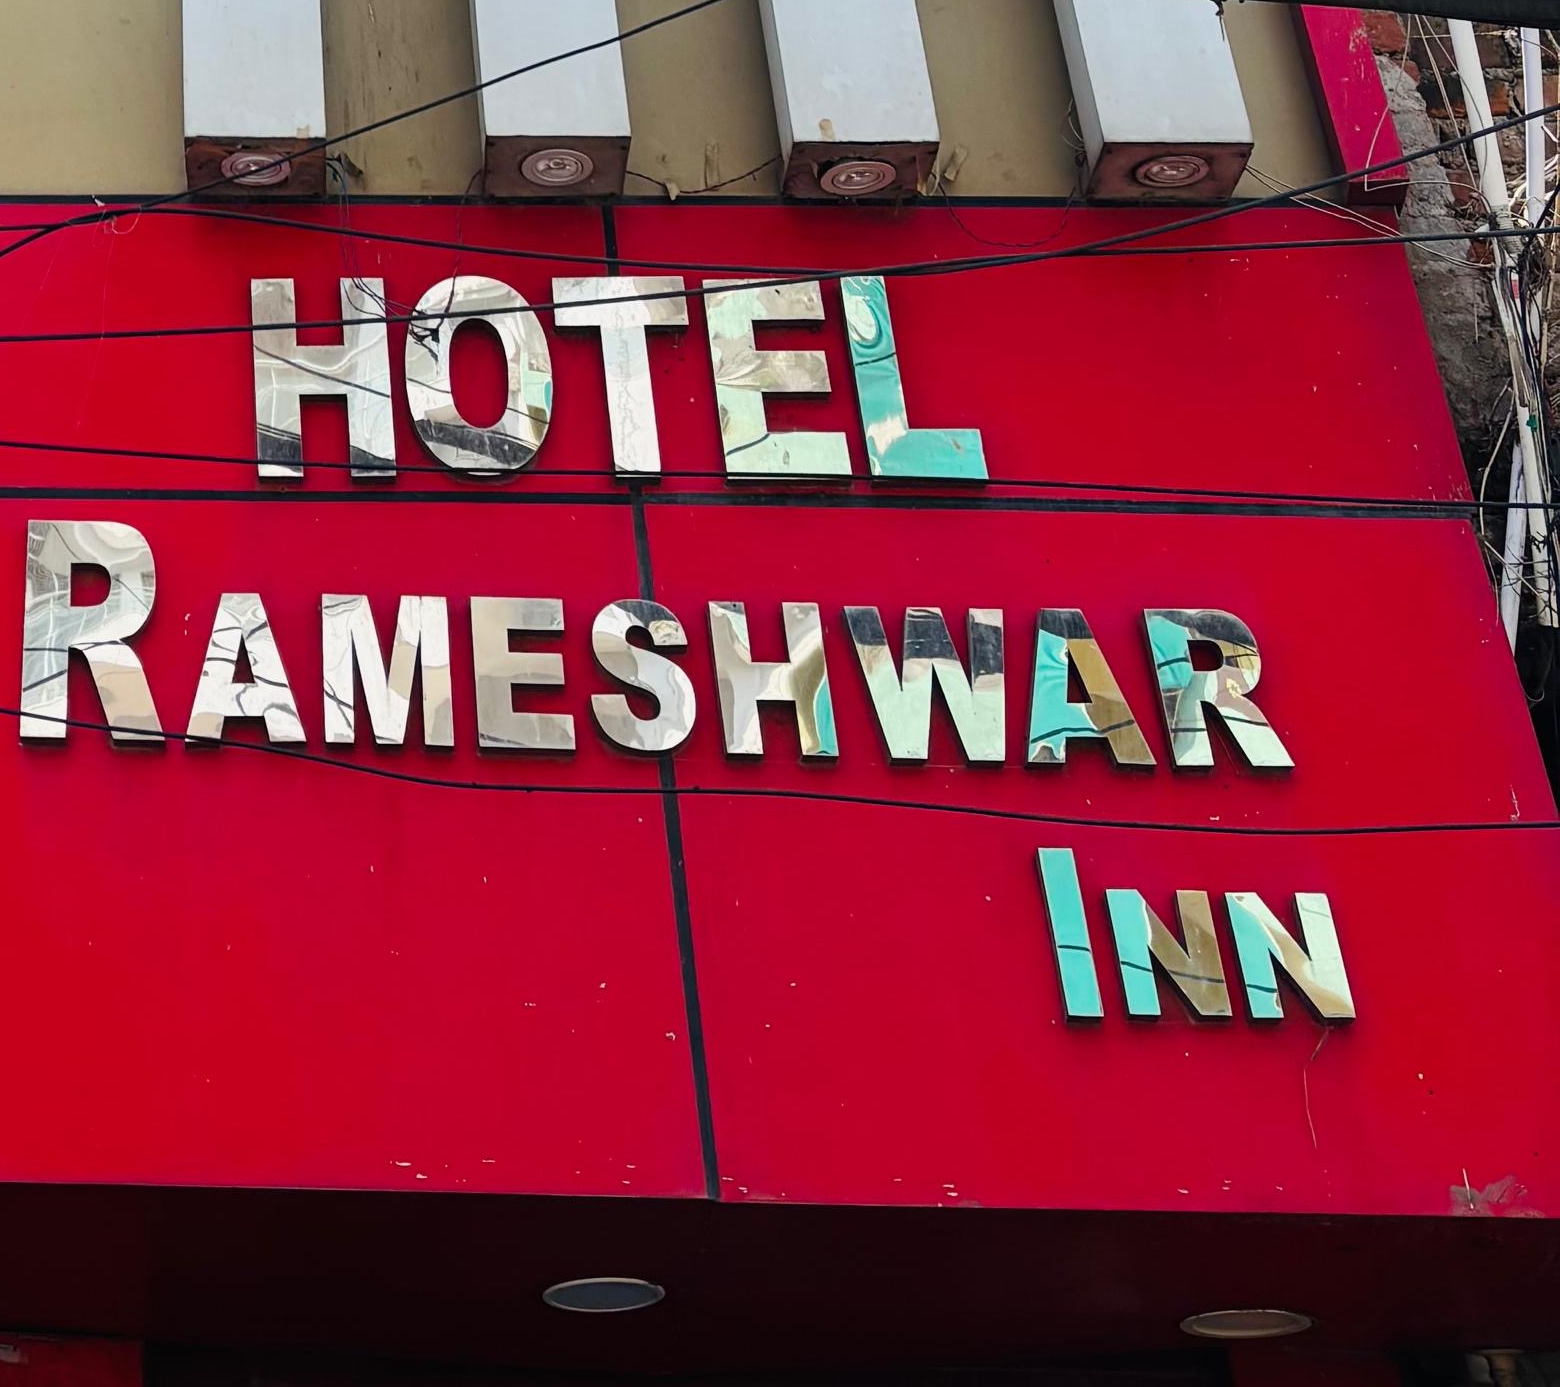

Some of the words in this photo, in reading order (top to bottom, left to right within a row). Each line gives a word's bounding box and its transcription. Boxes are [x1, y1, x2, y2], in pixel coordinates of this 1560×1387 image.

[251, 274, 989, 487] HOTEL
[19, 519, 1296, 772] RAMESHWAR
[1037, 847, 1356, 1024] INN
